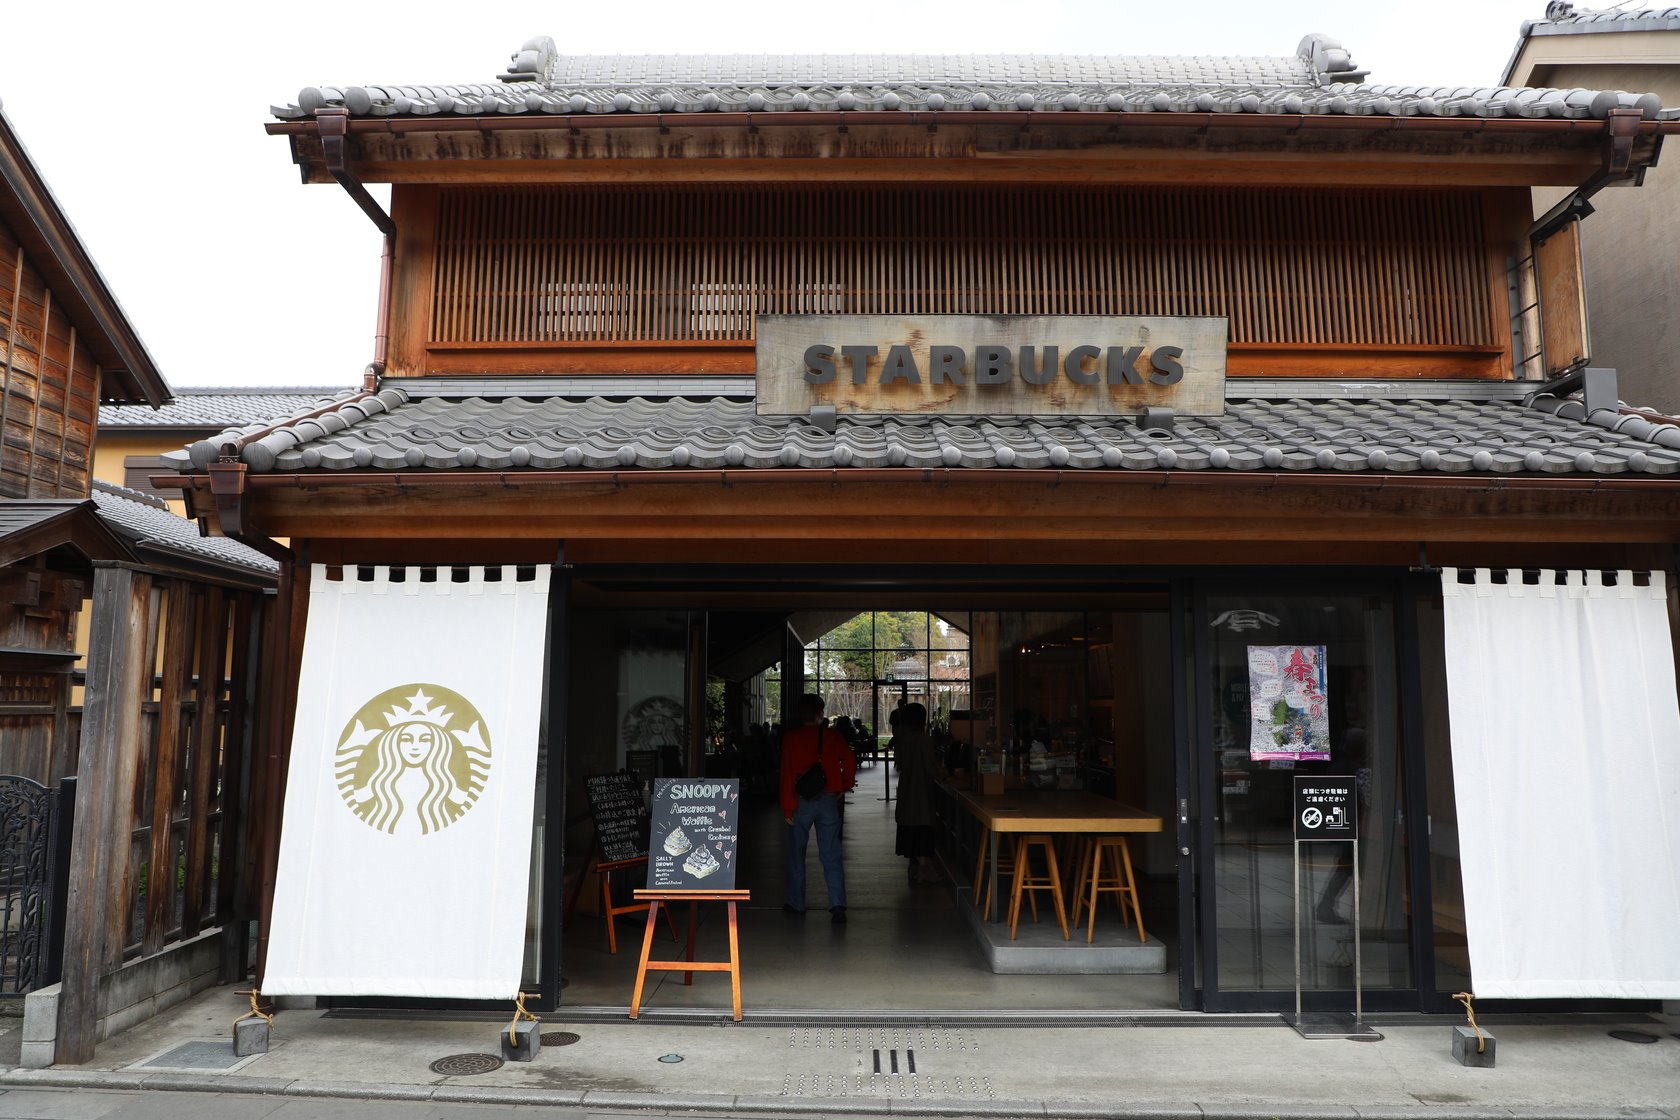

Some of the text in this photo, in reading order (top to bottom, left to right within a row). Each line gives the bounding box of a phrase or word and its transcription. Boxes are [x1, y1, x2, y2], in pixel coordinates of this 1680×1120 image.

[803, 344, 1184, 385] STARBUCKS
[669, 784, 731, 800] SNOOPY
[670, 802, 716, 814] American
[681, 816, 713, 826] Waffle
